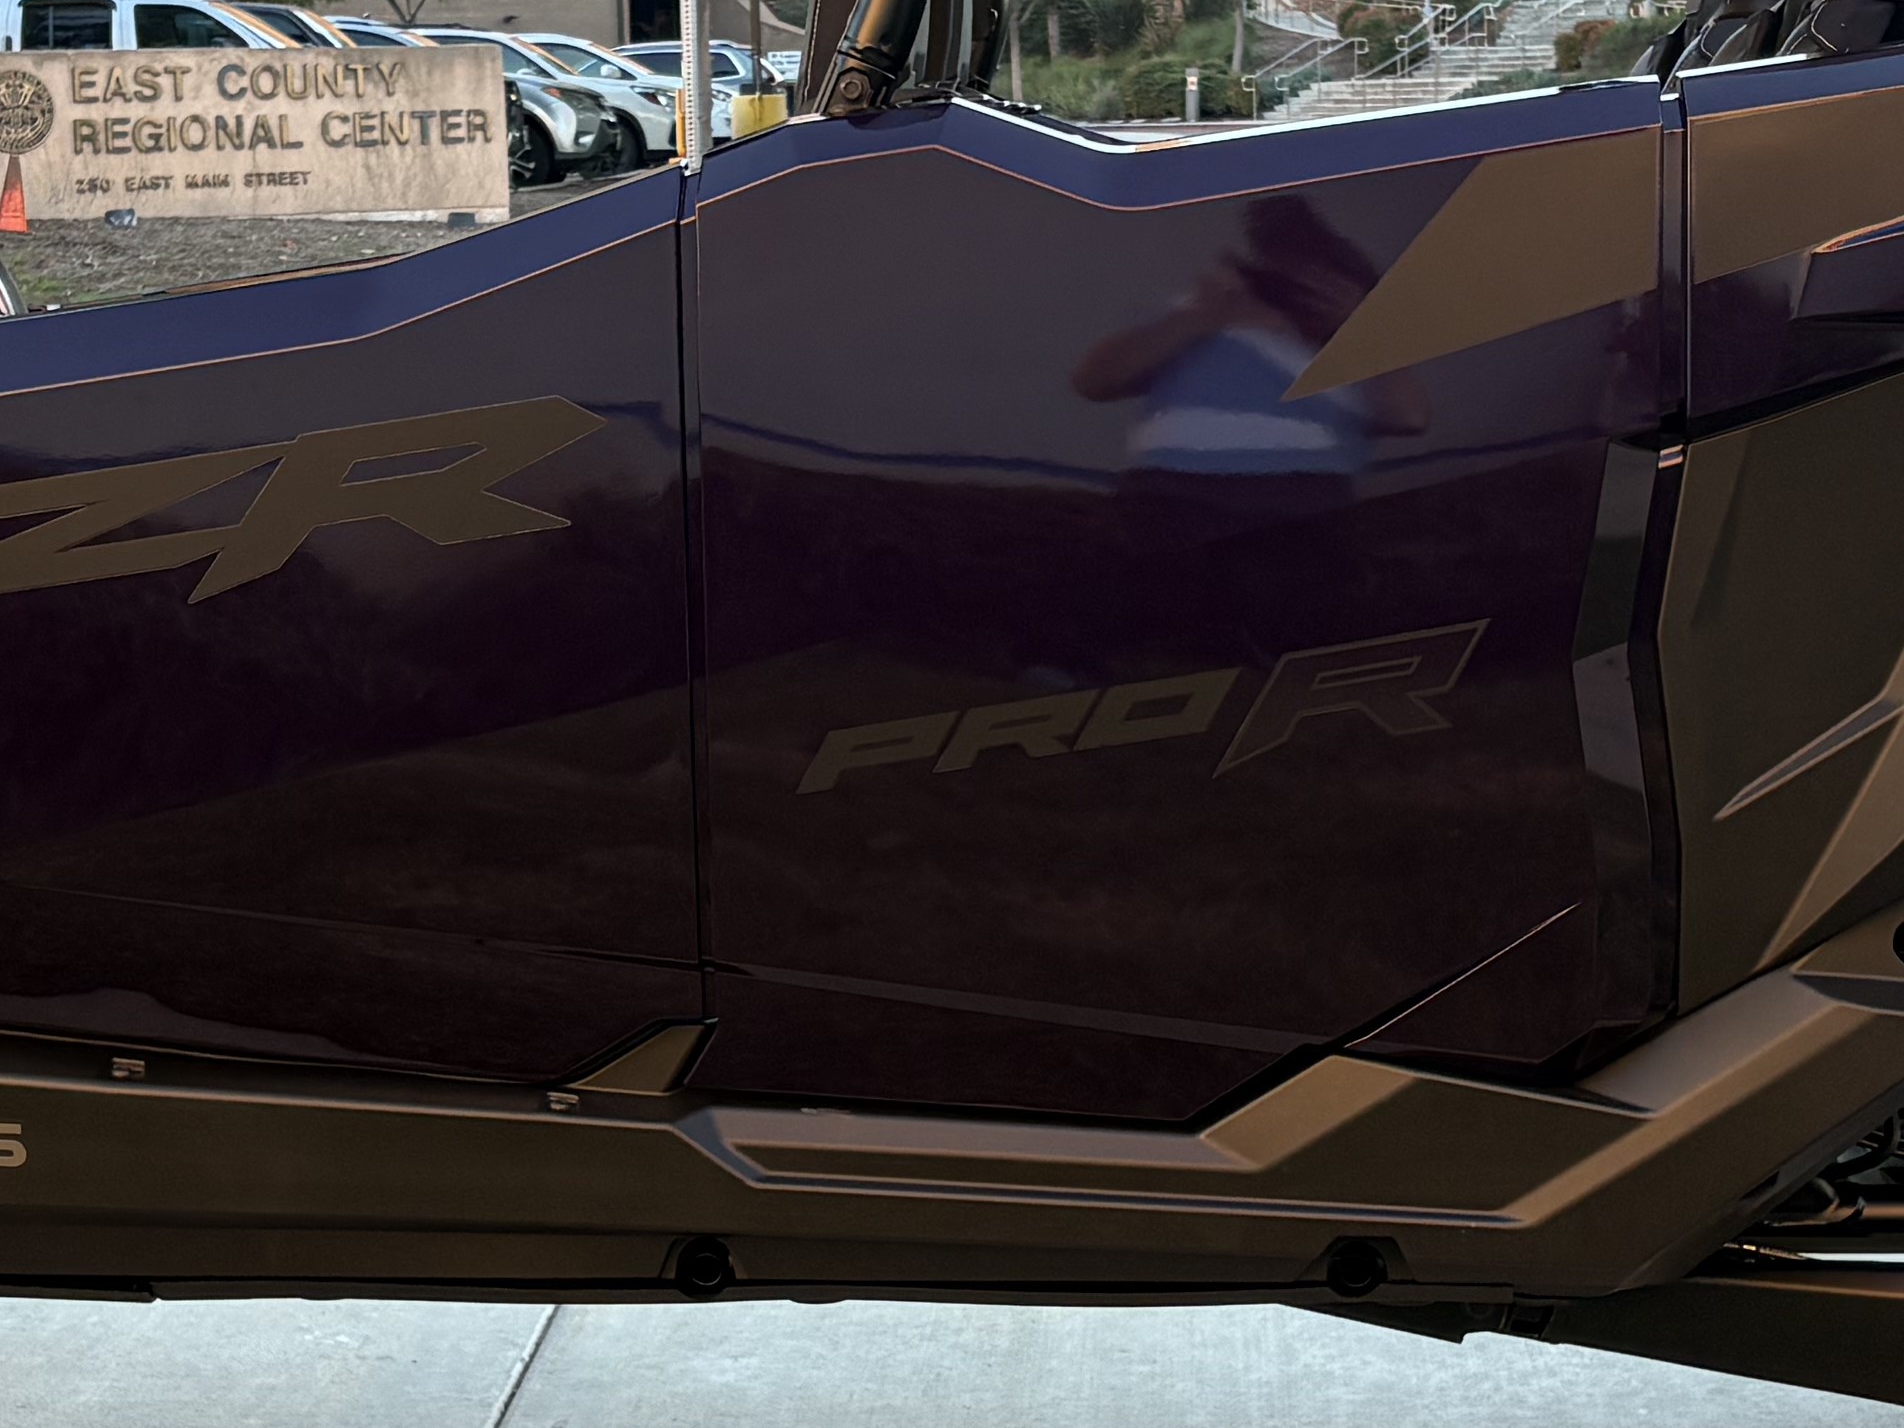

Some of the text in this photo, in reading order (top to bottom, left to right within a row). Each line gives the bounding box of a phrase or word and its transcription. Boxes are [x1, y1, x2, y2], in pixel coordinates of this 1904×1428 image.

[70, 62, 402, 104] EAST COUNTY
[73, 108, 492, 155] REGIONAL CENTER
[124, 175, 174, 193] EAST
[184, 174, 231, 190] MAIN
[244, 171, 312, 188] STREET
[796, 618, 1491, 794] PRO R
